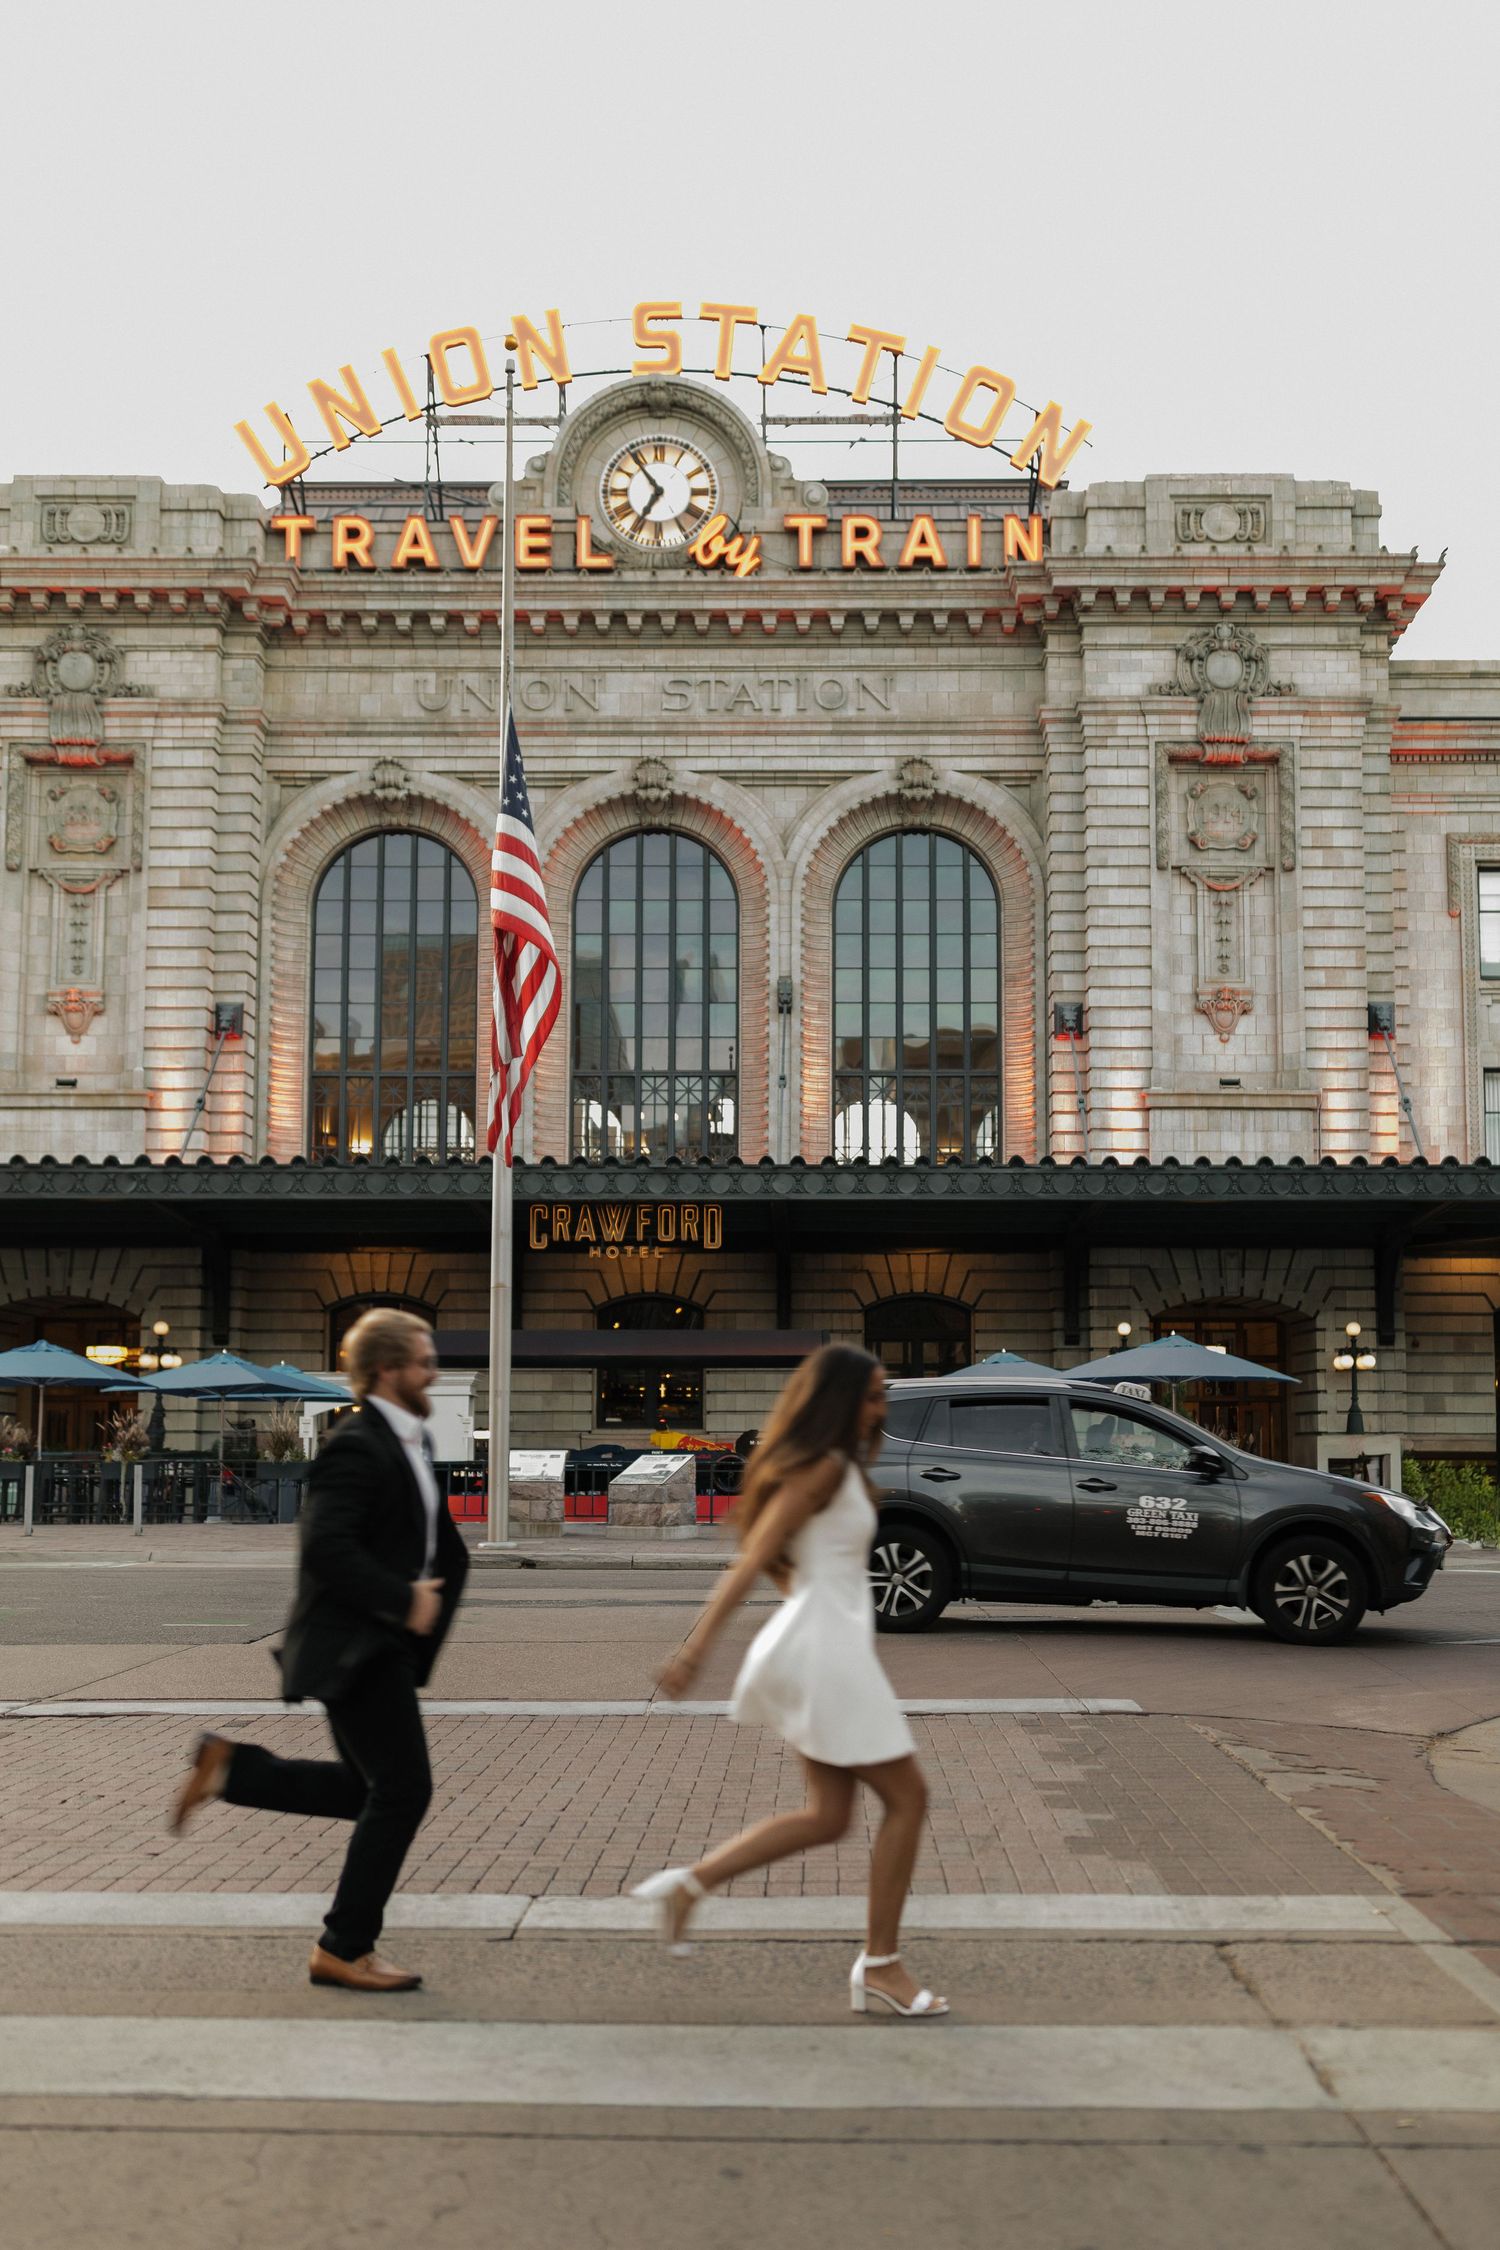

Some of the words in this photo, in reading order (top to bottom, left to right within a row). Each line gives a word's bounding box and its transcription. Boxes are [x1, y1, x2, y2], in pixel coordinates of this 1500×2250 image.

[234, 309, 573, 487] UNION
[631, 302, 1093, 490] STATION
[271, 514, 615, 569] TRAVEL
[688, 513, 762, 577] by
[784, 514, 1044, 569] TRAIN
[414, 678, 604, 712] UNON
[661, 677, 894, 712] STATION
[529, 1204, 722, 1249] CRAWFORD
[589, 1246, 664, 1259] HOTEL
[1120, 1384, 1146, 1399] TAXI
[1126, 1508, 1167, 1519] GREEN
[1169, 1511, 1199, 1521] TAXI
[1138, 1495, 1188, 1511] 632
